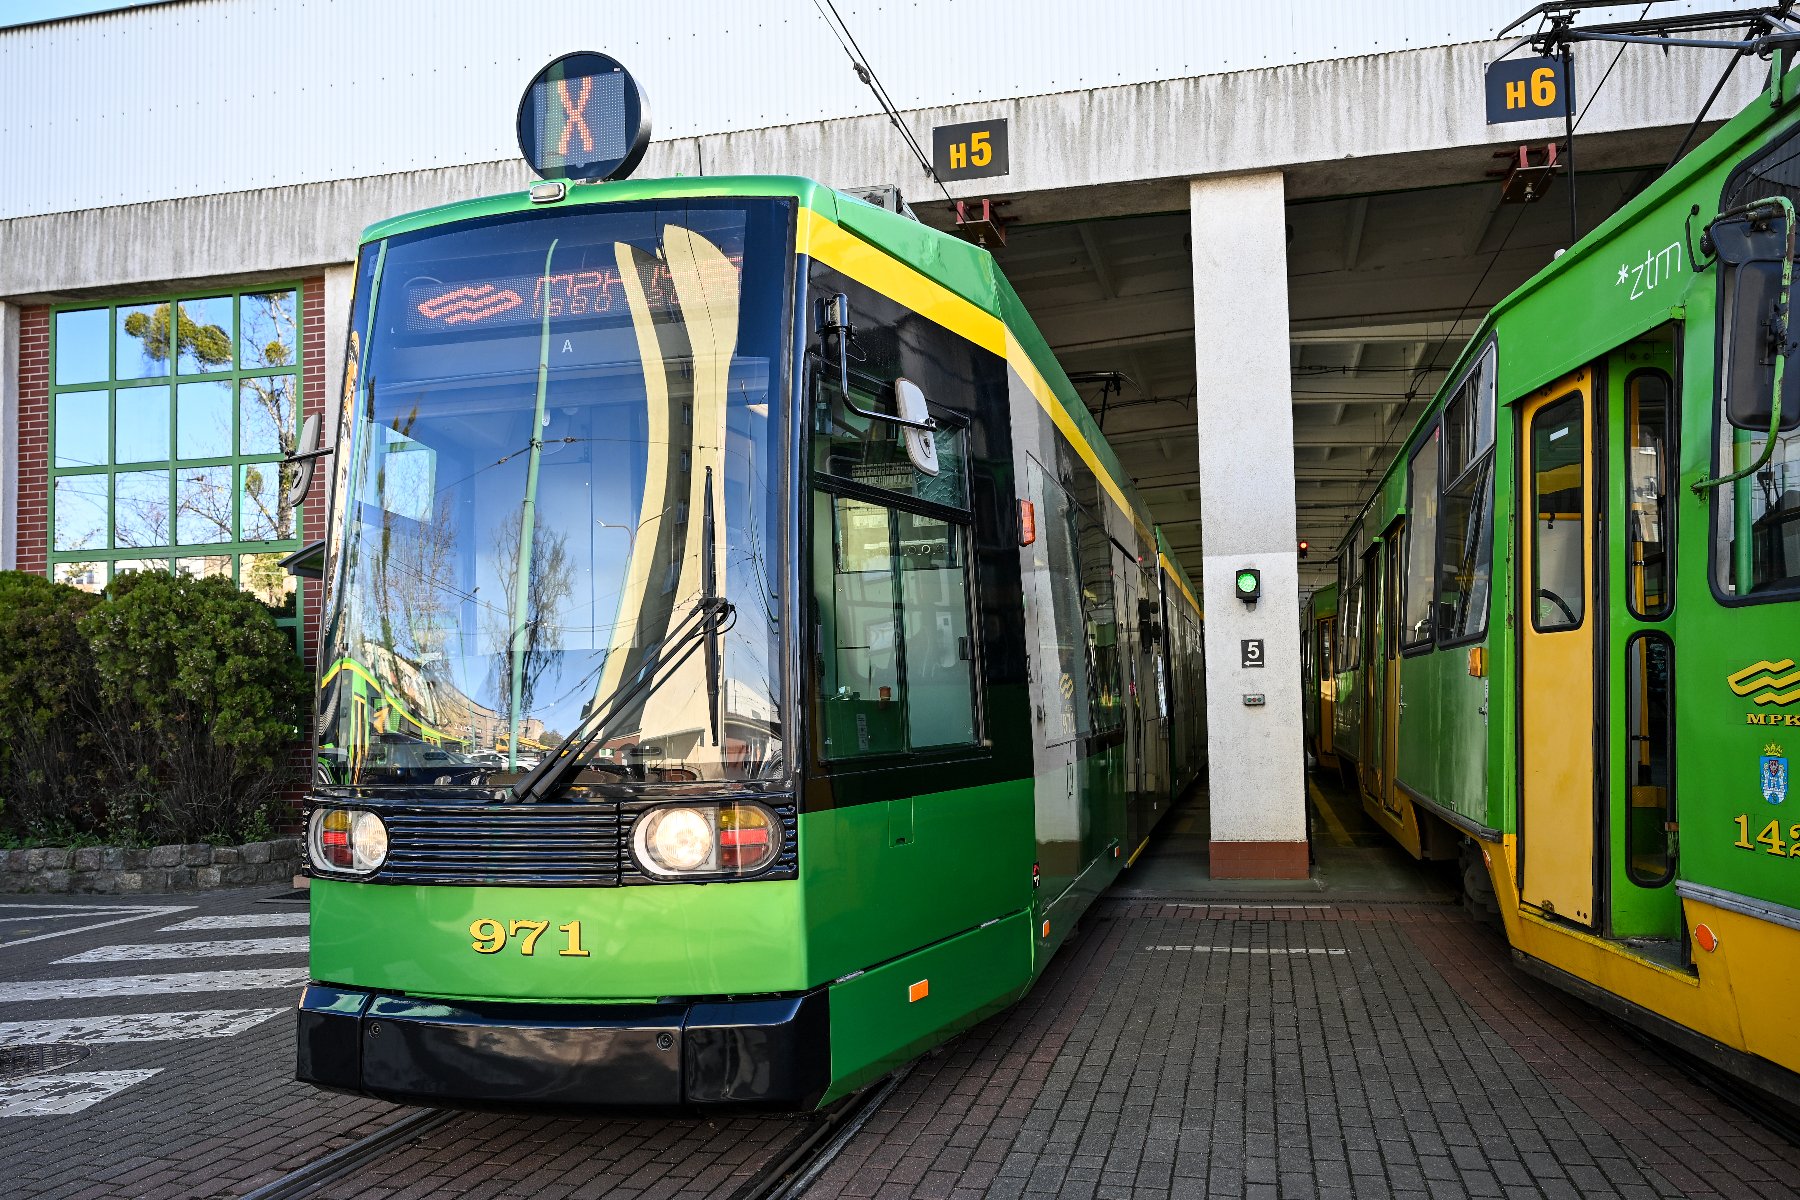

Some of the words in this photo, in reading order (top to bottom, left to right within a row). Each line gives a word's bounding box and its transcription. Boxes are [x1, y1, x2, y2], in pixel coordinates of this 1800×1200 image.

[1506, 67, 1556, 109] H6
[557, 76, 593, 155] X
[949, 131, 992, 169] H5
[561, 339, 573, 353] A
[1247, 641, 1260, 659] 5
[1746, 713, 1800, 726] MPK
[469, 918, 591, 957] 971
